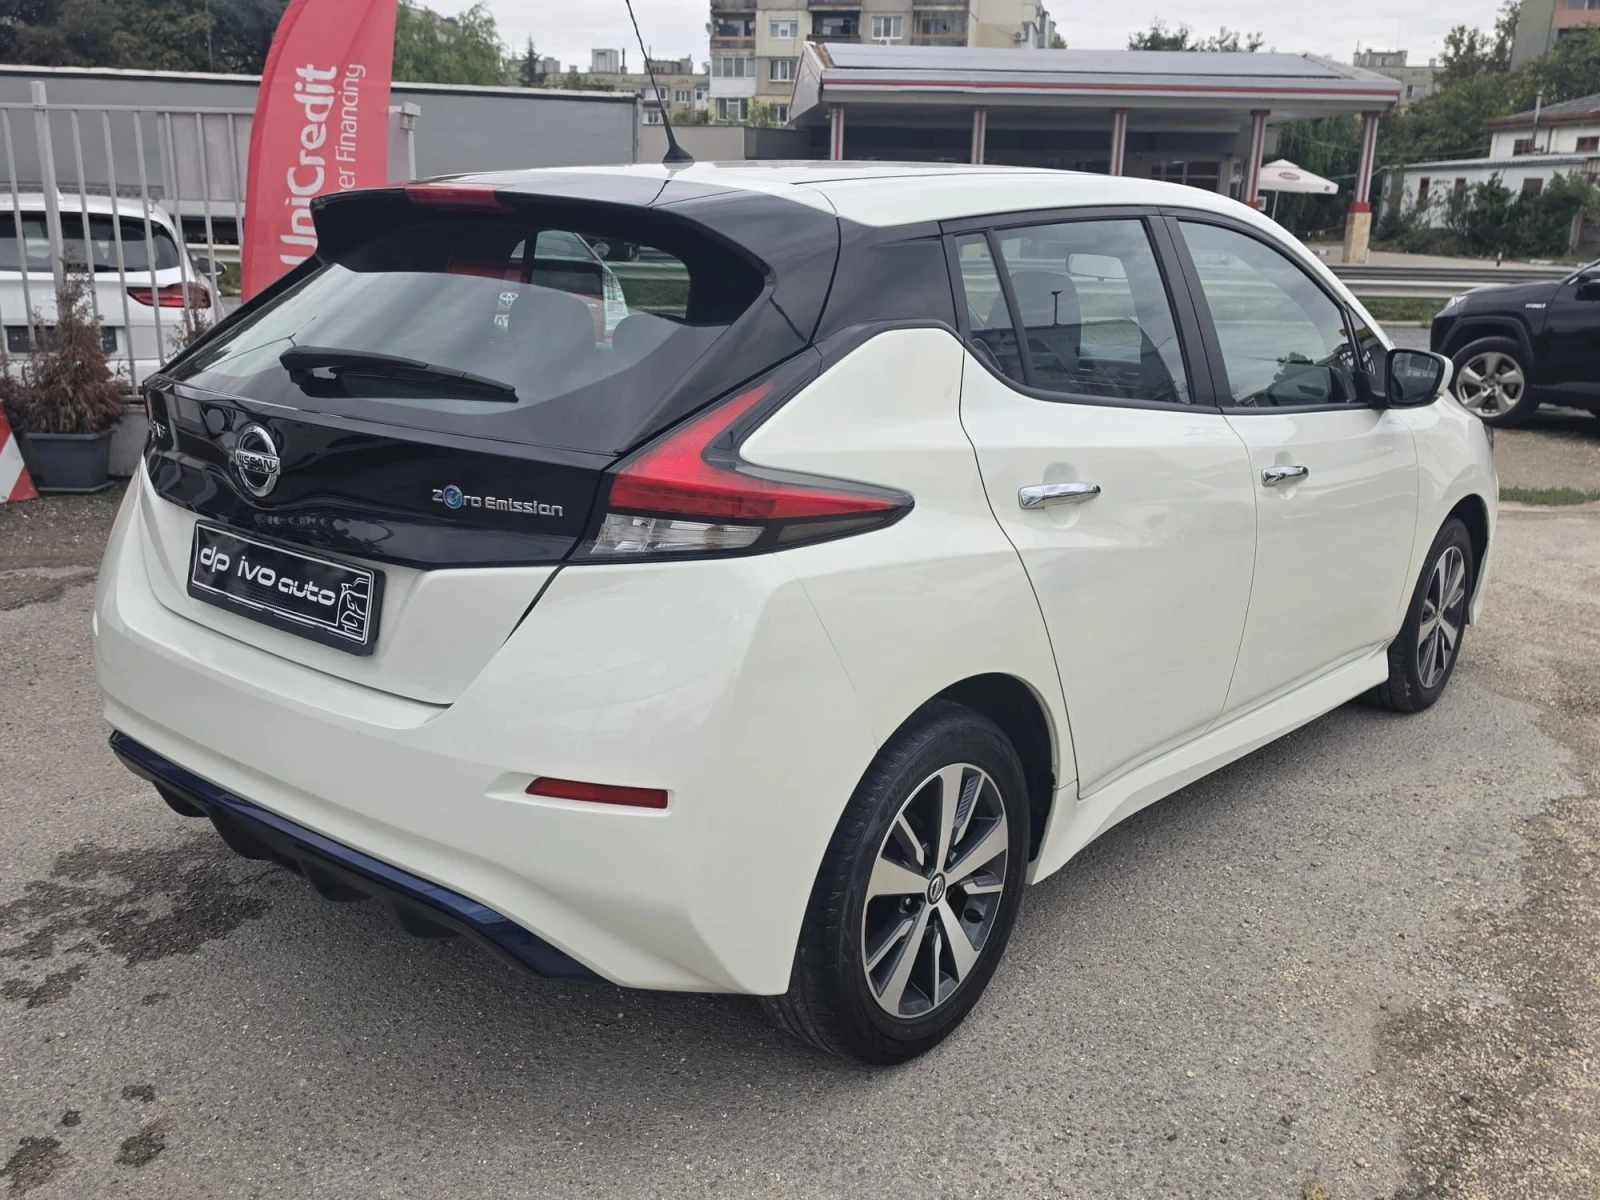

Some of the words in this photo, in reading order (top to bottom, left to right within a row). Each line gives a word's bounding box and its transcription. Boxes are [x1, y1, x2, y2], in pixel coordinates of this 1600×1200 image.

[335, 63, 367, 163] Financing
[279, 63, 338, 266] UniCredit
[338, 166, 356, 192] er
[236, 452, 278, 474] NISSAN
[484, 496, 563, 517] Emission
[199, 546, 230, 573] dp
[237, 555, 276, 588] ivo
[277, 576, 337, 607] auto
